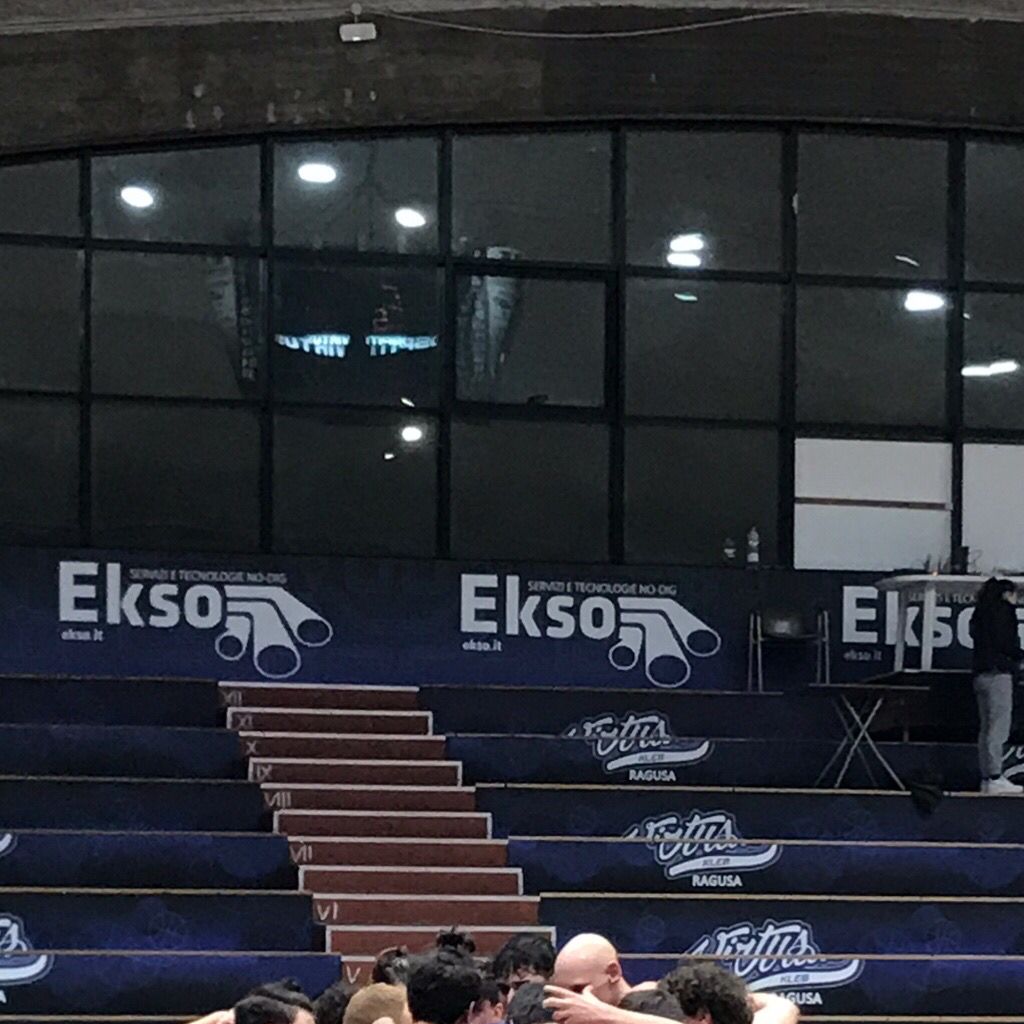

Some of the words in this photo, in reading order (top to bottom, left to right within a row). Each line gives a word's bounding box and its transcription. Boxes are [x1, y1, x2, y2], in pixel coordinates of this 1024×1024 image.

[59, 561, 223, 629] Ekso
[528, 580, 565, 592] SERVIZI
[574, 582, 636, 595] TECNOLOGIE
[461, 573, 616, 640] Ekso
[463, 640, 502, 651] ekso.it
[247, 741, 257, 755] X
[256, 765, 272, 780] IX
[629, 769, 676, 782] RAGUSA
[264, 791, 292, 808] VIII
[289, 844, 313, 863] VII
[692, 875, 743, 887] RAGUSA
[316, 902, 339, 921] VI
[346, 965, 361, 984] V
